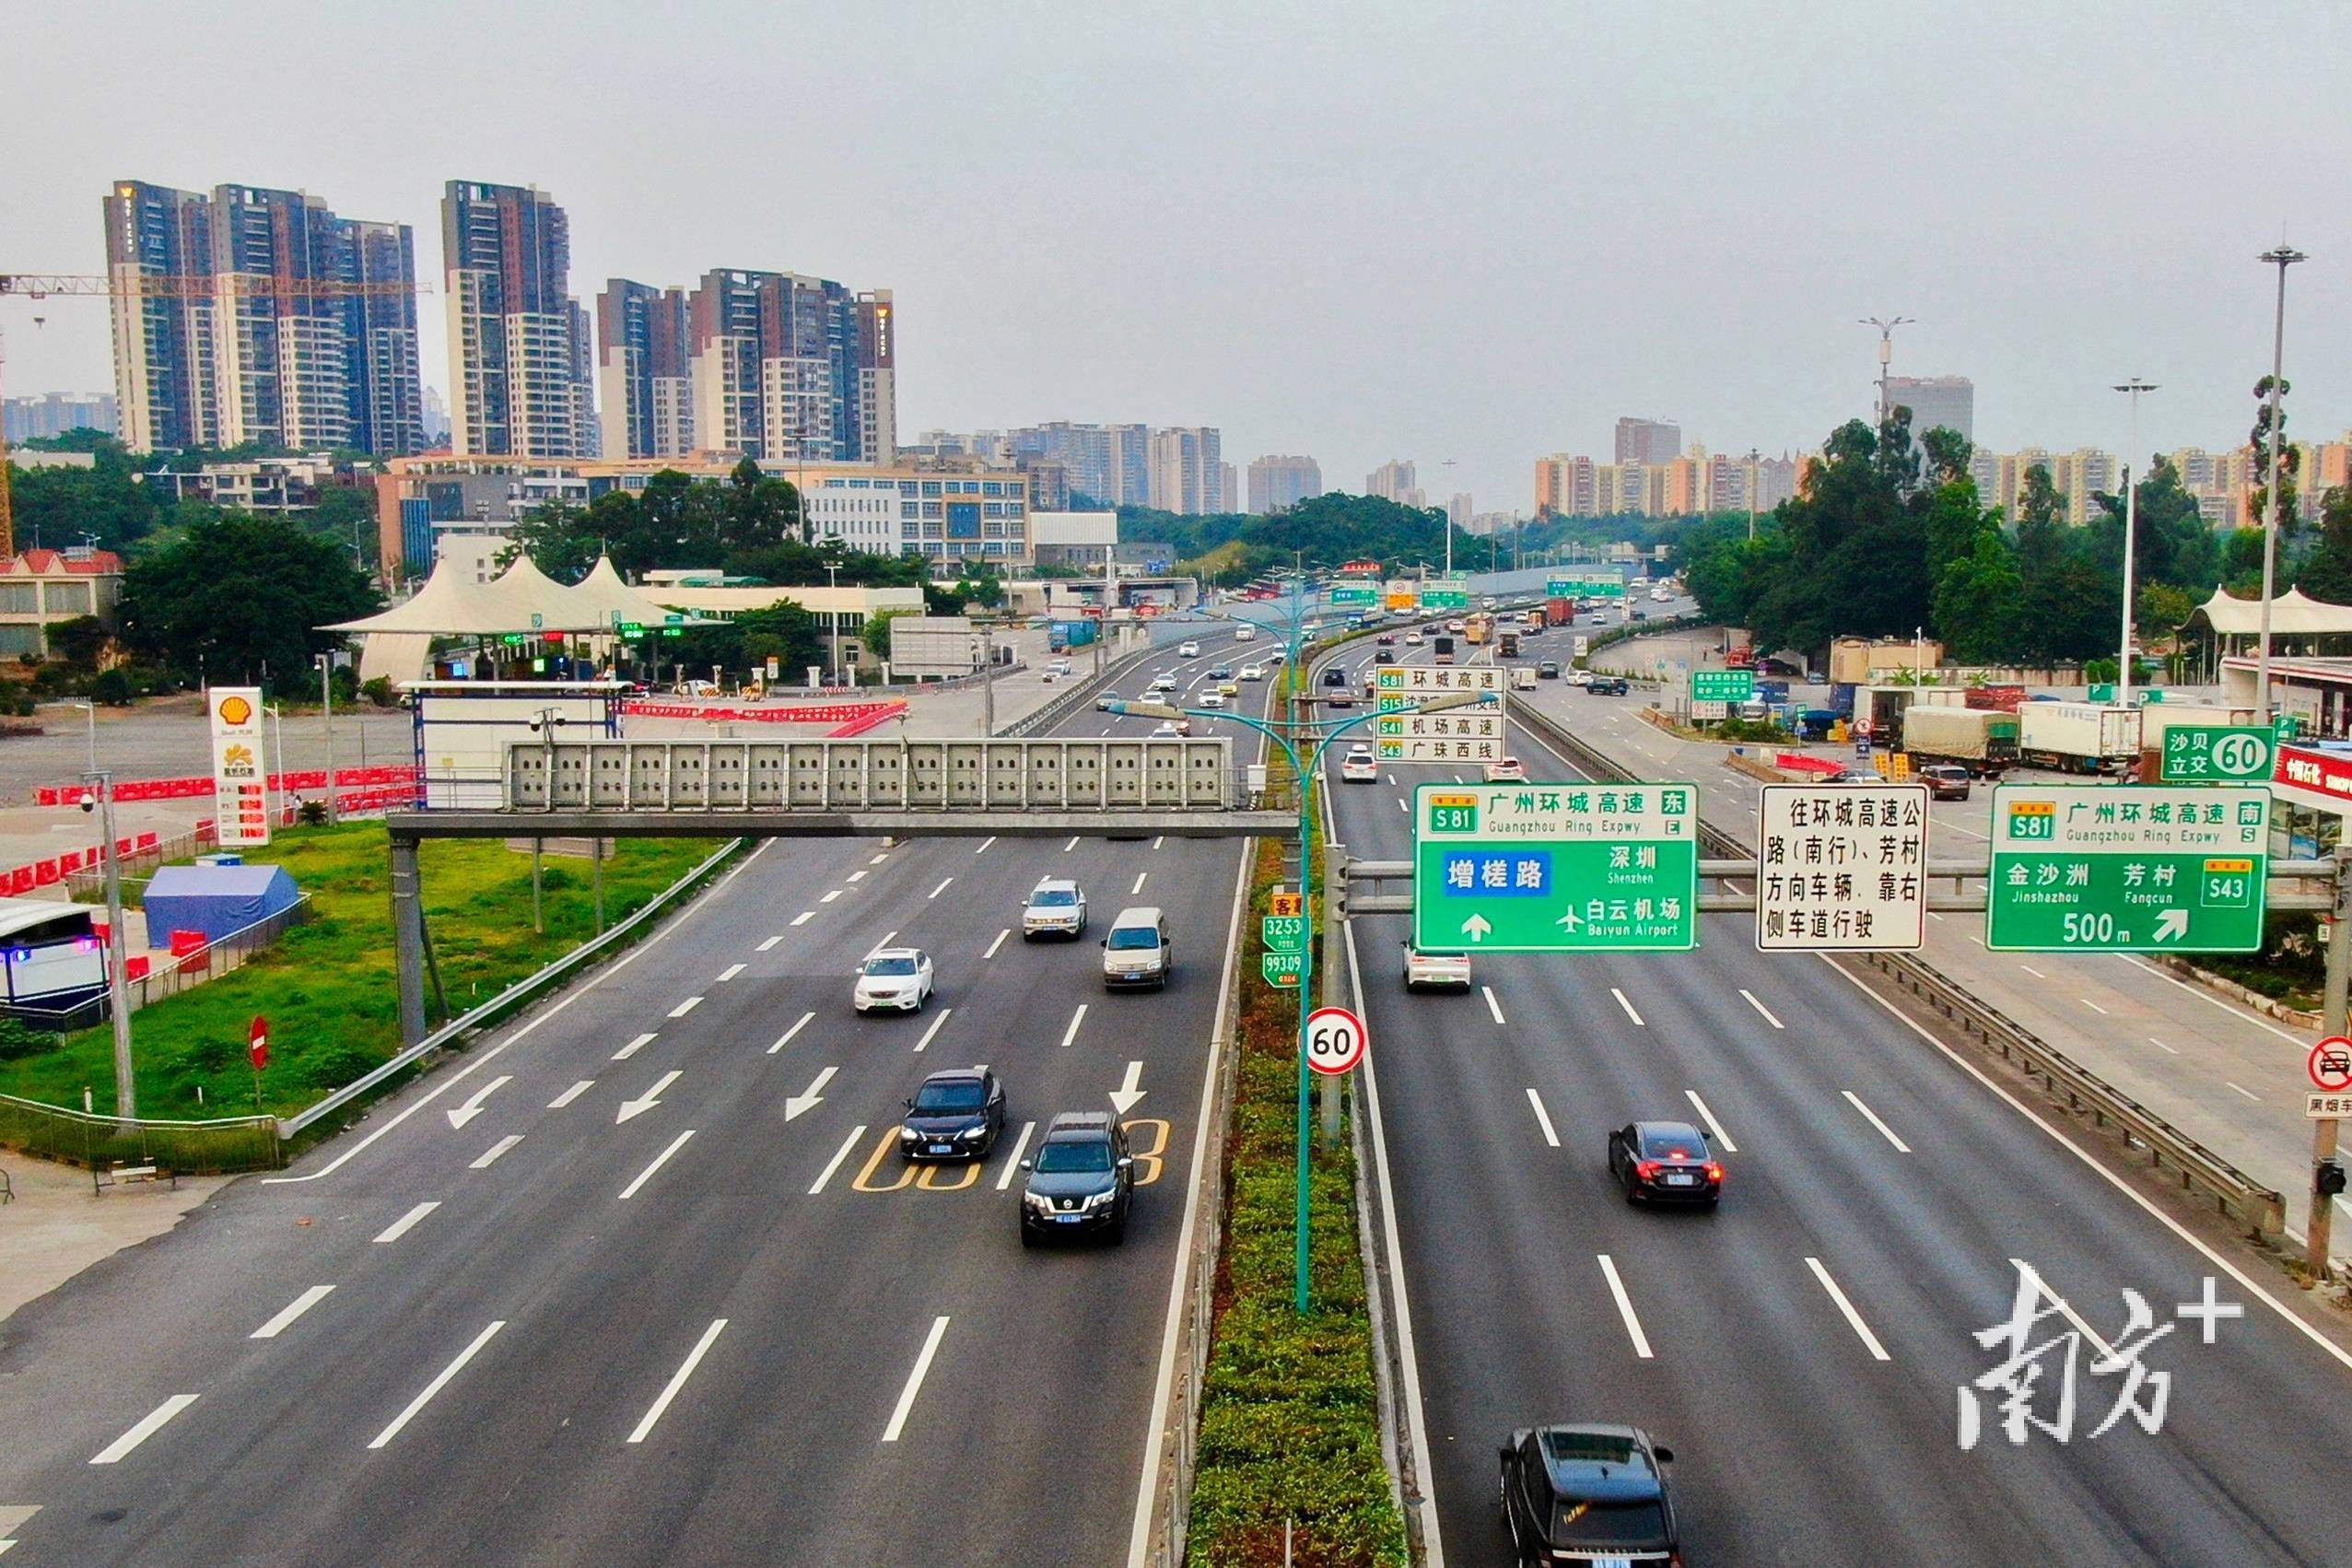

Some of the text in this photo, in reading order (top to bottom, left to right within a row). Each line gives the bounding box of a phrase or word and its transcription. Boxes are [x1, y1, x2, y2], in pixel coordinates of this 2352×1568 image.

[1382, 671, 1494, 688] S81 环城高速
[1381, 699, 1401, 710] S15
[1381, 719, 1493, 736] S41 机场高速
[1380, 741, 1493, 759] S43 广珠西线
[2170, 733, 2208, 752] 沙贝
[2221, 736, 2256, 770] 60
[2169, 755, 2208, 775] 立交
[1436, 810, 1469, 828] S81
[1489, 791, 1645, 814] 广州环城高速
[1664, 791, 1685, 813] 东
[1789, 797, 1922, 827] 往环城高速公
[2015, 802, 2261, 837] S81 广州环城高速 南
[1489, 820, 1556, 836] Guangzhou
[1565, 820, 1592, 835] Ring
[1601, 821, 1642, 835] Expwy
[2066, 829, 2136, 845] Guangzhou
[2144, 829, 2171, 844] Ring
[2181, 830, 2220, 845] Expwy
[1609, 846, 1657, 870] 深圳
[1447, 859, 1543, 888] 增槎路
[1608, 872, 1654, 884] Shenzhen
[2006, 862, 2244, 898] 金沙洲 芳村 S43
[2011, 890, 2173, 907] Jinshazhou Fangcun
[1586, 897, 1681, 921] 白云机场
[1587, 924, 1679, 937] Baiyun Airport
[1766, 909, 1874, 939] 侧车道行驶
[1313, 1028, 1351, 1056] 60
